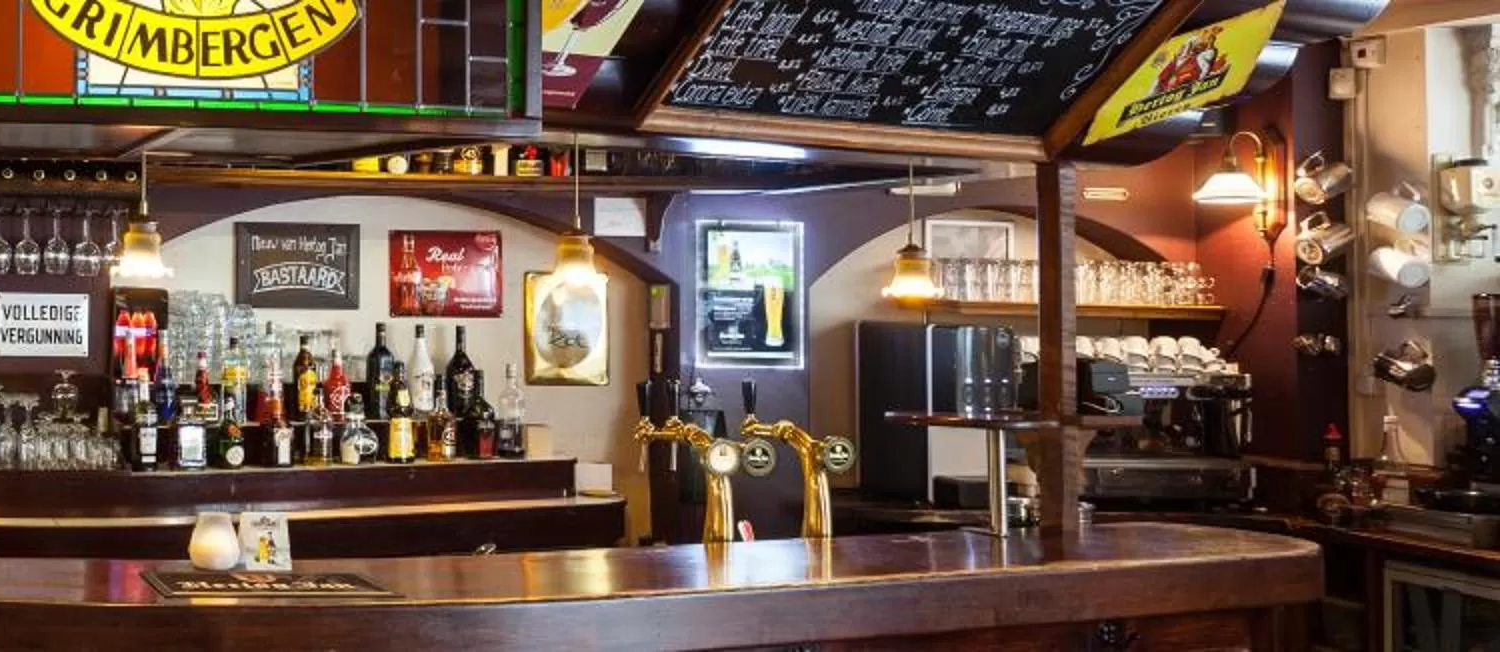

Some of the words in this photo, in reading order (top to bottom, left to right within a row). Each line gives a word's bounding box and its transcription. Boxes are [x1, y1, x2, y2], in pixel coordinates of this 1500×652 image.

[425, 246, 466, 263] Real
[261, 266, 338, 289] BASTAARD
[1, 304, 84, 321] VOLLEDIGE
[0, 327, 83, 345] VERGUNNING
